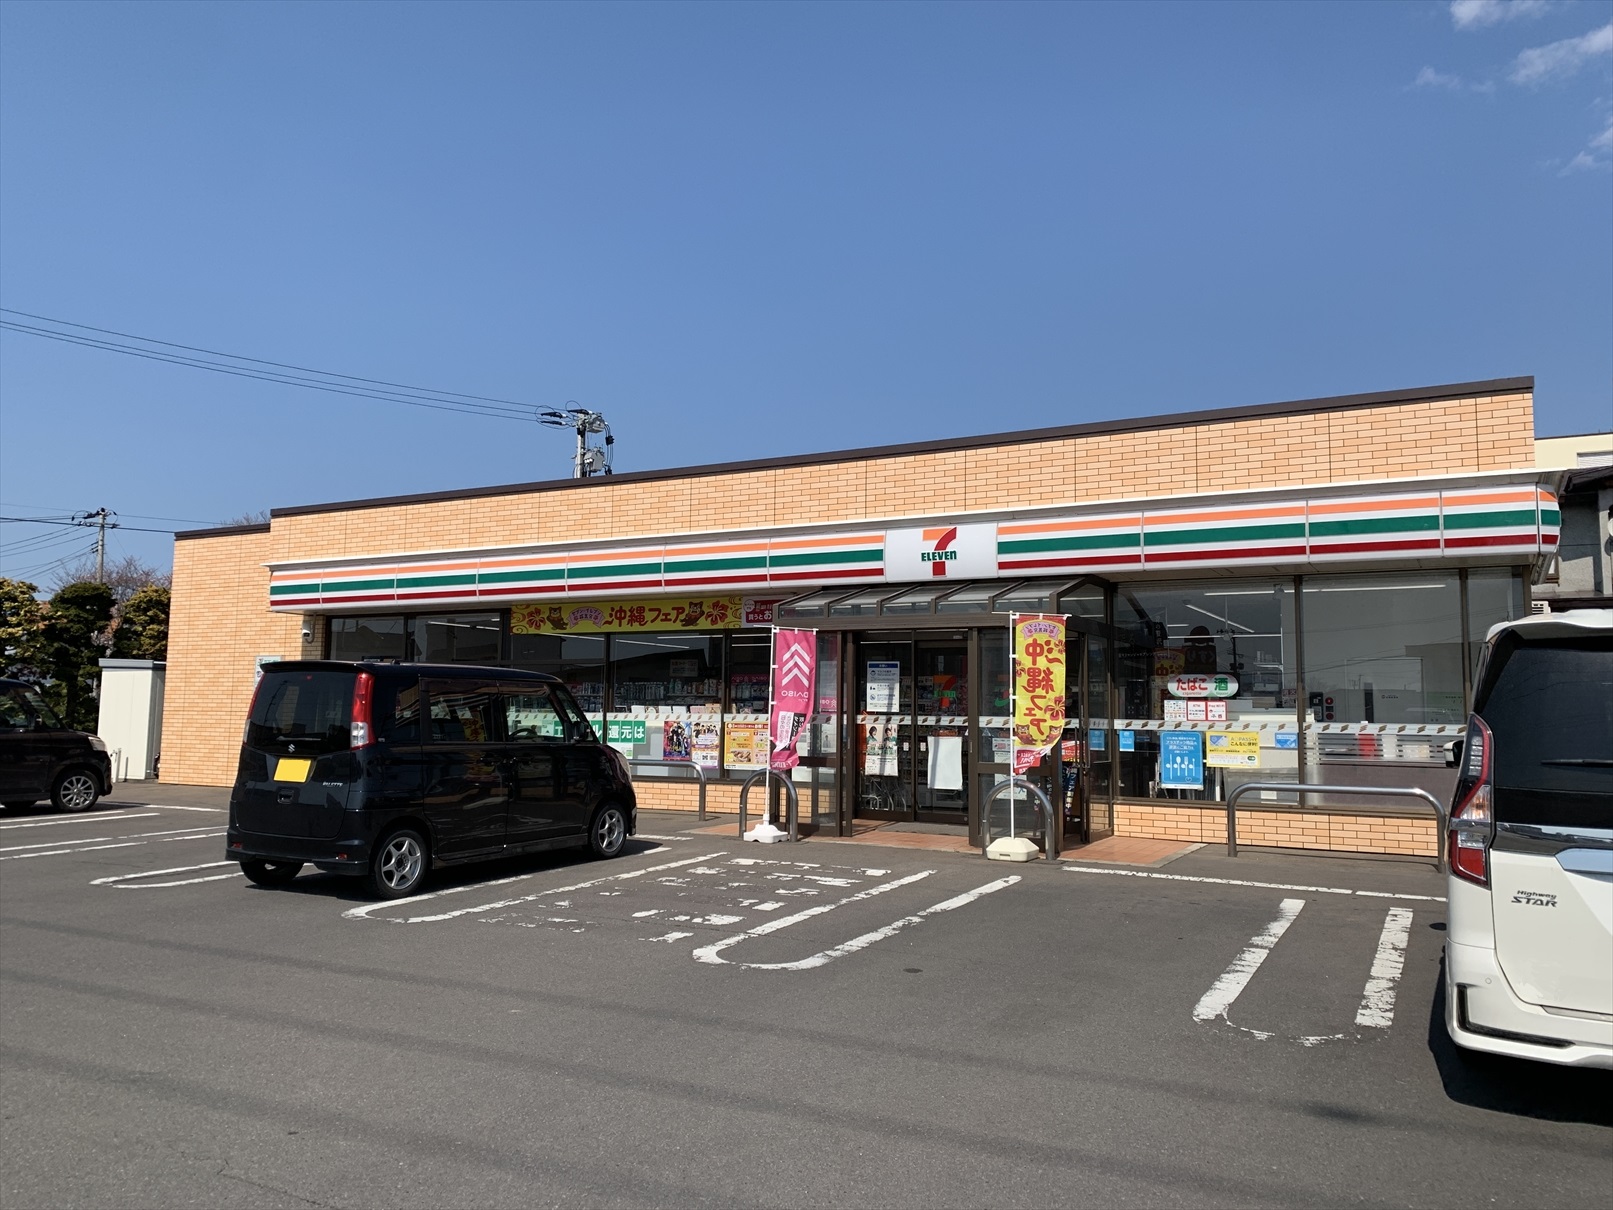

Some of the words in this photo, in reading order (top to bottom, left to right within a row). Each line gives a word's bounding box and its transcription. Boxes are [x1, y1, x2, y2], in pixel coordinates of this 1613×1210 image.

[923, 527, 957, 576] 7
[603, 606, 686, 627] 沖縄フェア
[1176, 677, 1208, 691] たばこ
[1214, 677, 1229, 691] 酒
[1511, 896, 1558, 908] STAR
[1517, 890, 1557, 900] Highway
